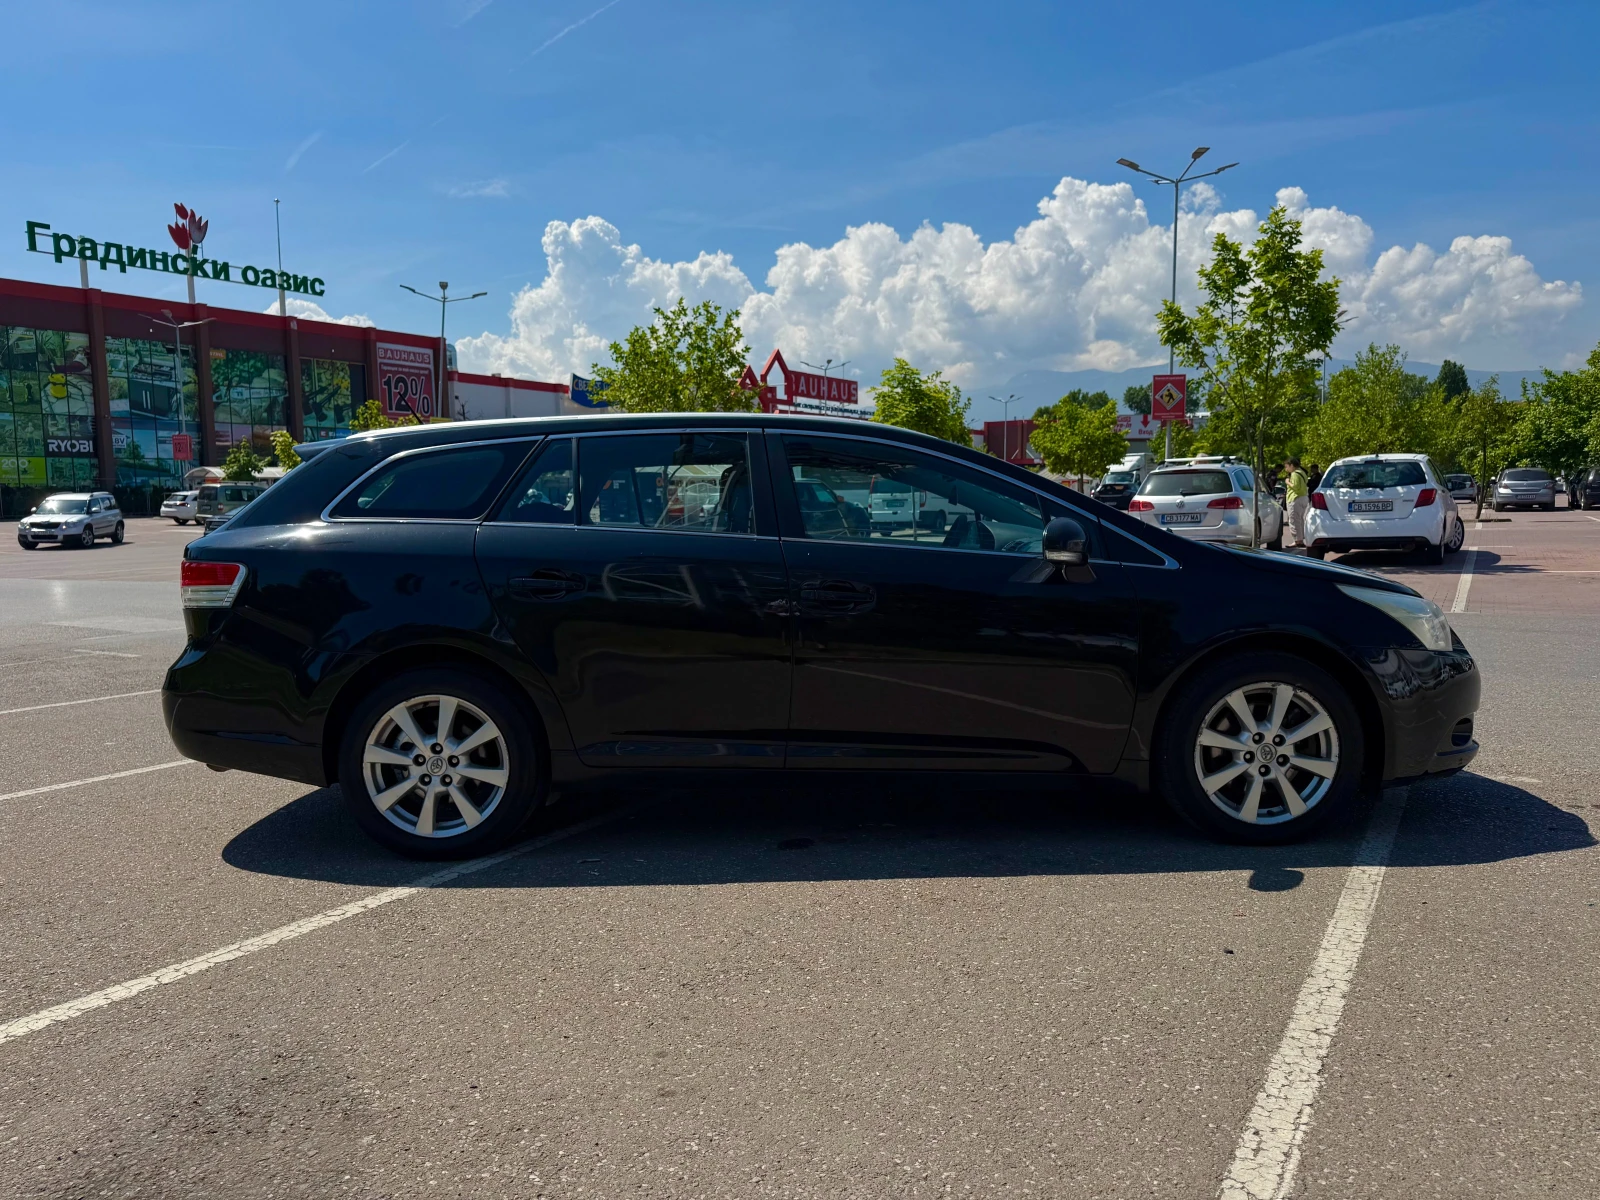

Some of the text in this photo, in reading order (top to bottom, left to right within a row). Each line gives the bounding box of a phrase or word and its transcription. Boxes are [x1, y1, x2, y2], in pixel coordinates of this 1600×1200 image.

[26, 220, 325, 297] Градински оазис
[378, 348, 430, 363] BAUHAUS
[382, 373, 431, 416] 12%
[47, 439, 95, 453] RYOBI
